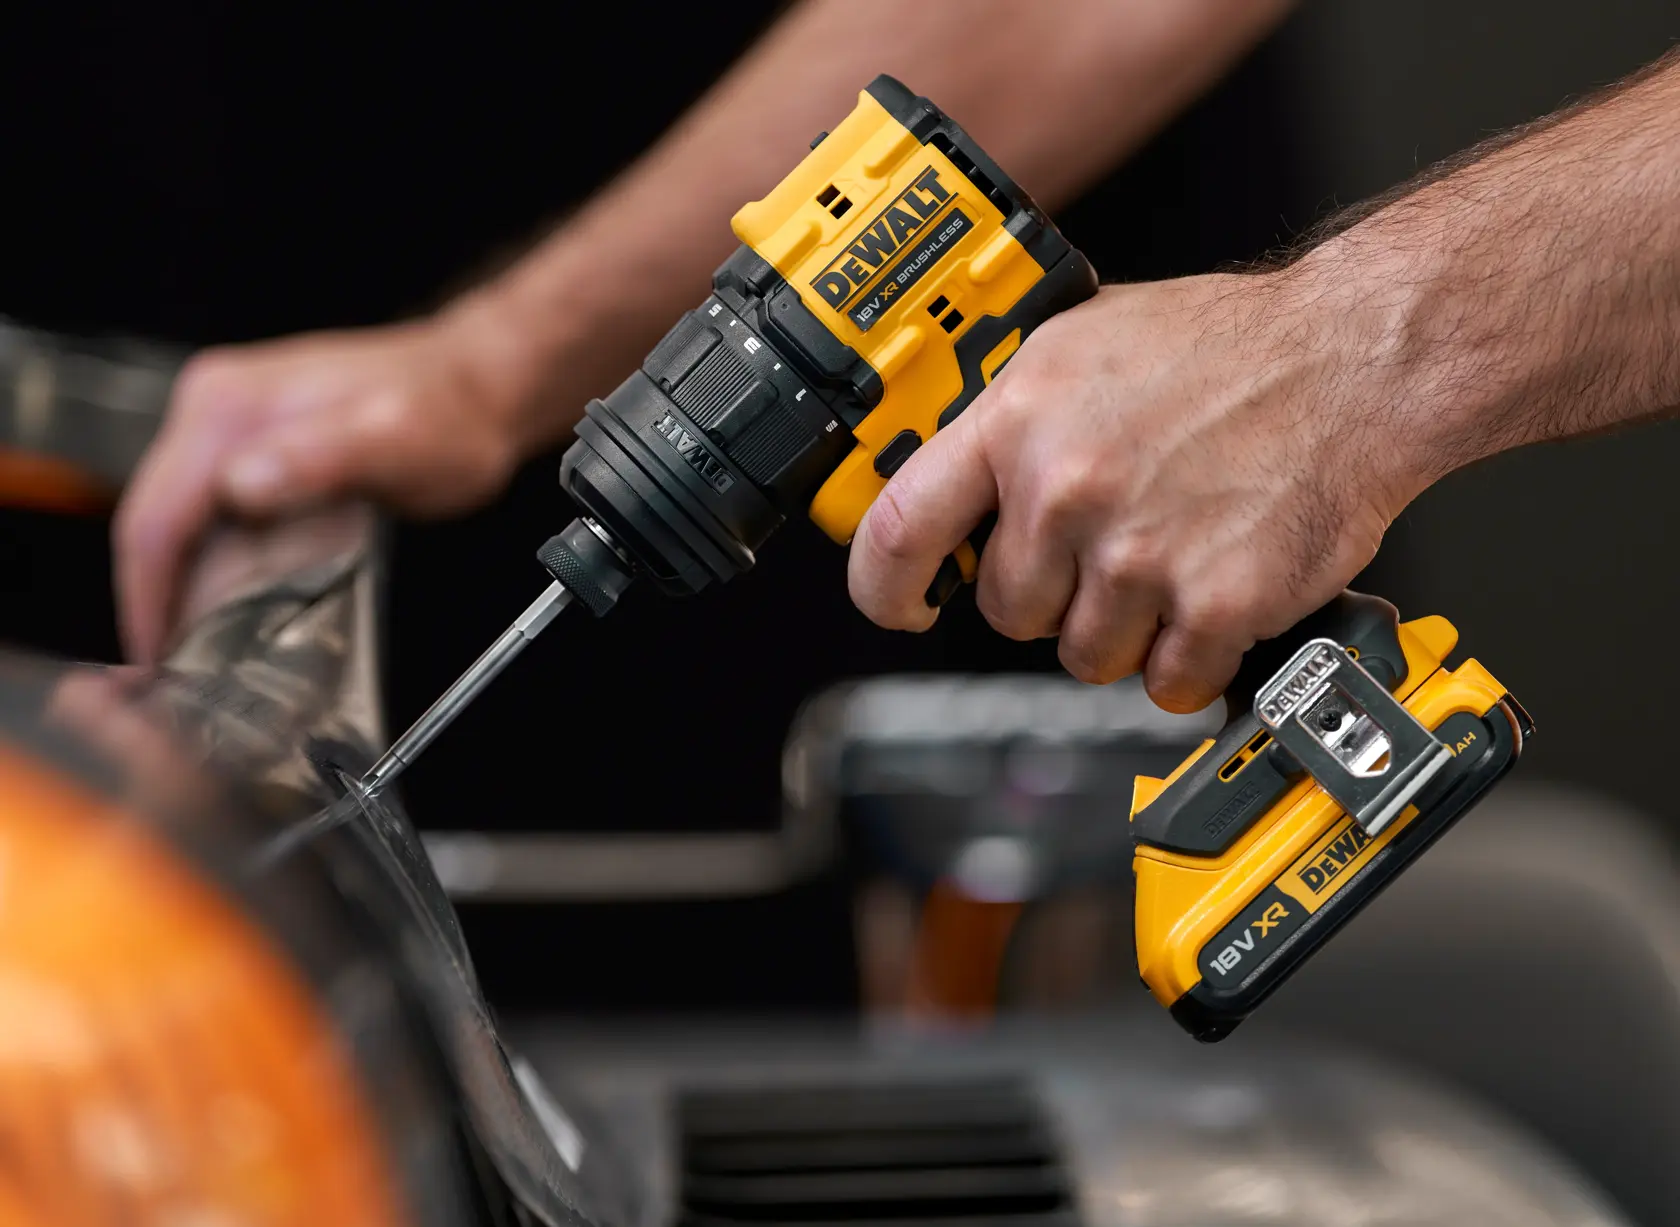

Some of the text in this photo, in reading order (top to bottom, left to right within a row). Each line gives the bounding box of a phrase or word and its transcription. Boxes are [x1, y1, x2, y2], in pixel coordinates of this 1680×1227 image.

[812, 168, 950, 310] DEWALT
[856, 218, 963, 322] 18V XR BRUSHLESS
[655, 412, 734, 494] DEWALT
[1260, 647, 1333, 722] DEWALT
[1209, 825, 1371, 976] 18V XR DEWA
